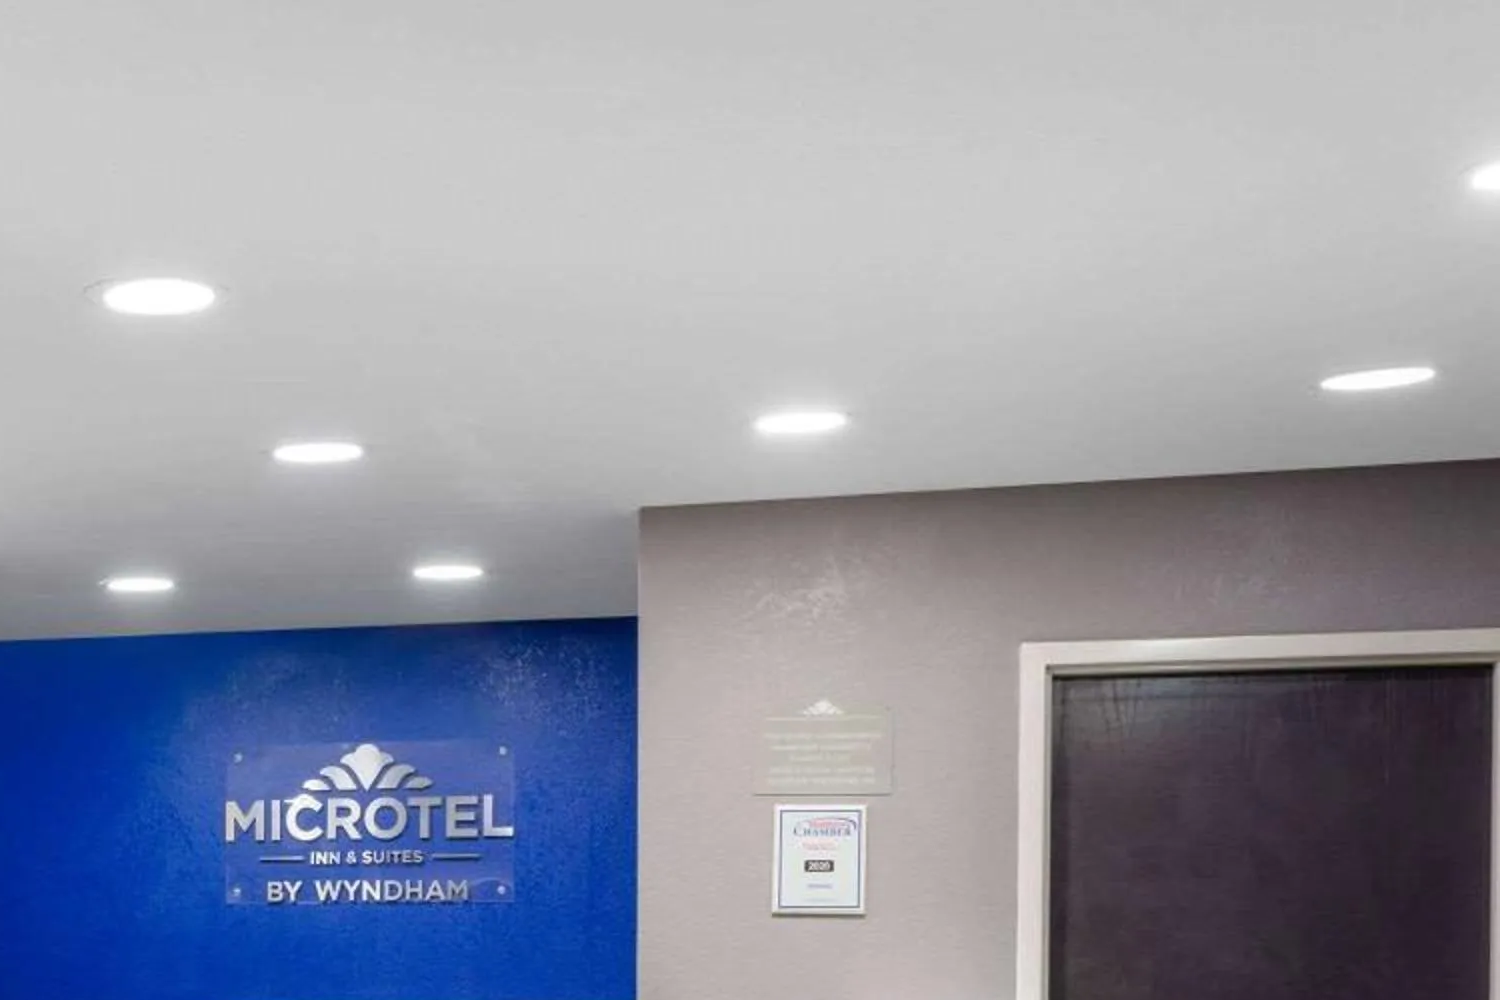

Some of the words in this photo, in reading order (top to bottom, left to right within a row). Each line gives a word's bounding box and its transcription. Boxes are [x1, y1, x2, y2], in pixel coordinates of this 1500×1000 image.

[225, 794, 514, 841] MICROTEL
[309, 851, 341, 865] INN
[346, 851, 356, 864] &
[362, 850, 424, 864] SUITES
[267, 880, 302, 902] BY
[314, 880, 469, 902] WYNDHAM
